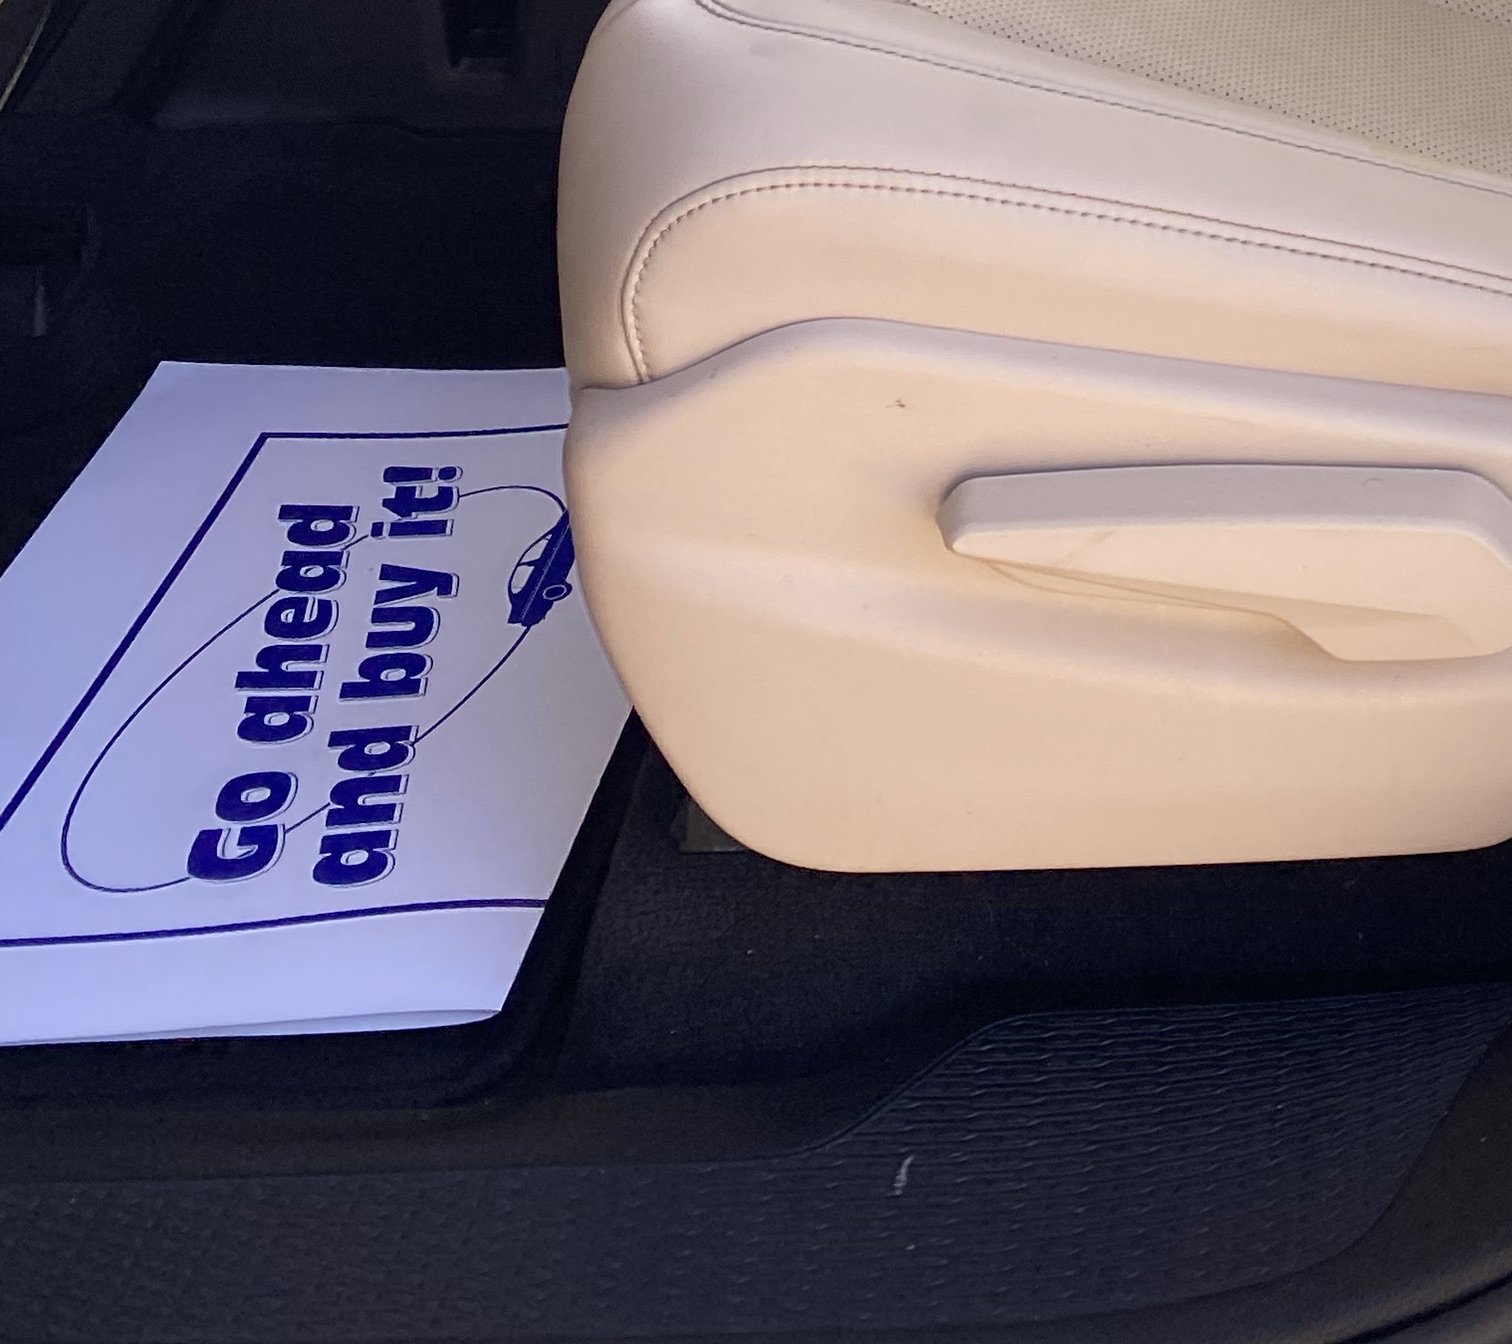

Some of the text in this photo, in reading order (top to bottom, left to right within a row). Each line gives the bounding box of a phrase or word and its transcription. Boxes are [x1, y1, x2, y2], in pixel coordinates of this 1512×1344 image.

[187, 504, 359, 884] Go ahead
[312, 465, 463, 888] and buy it!
